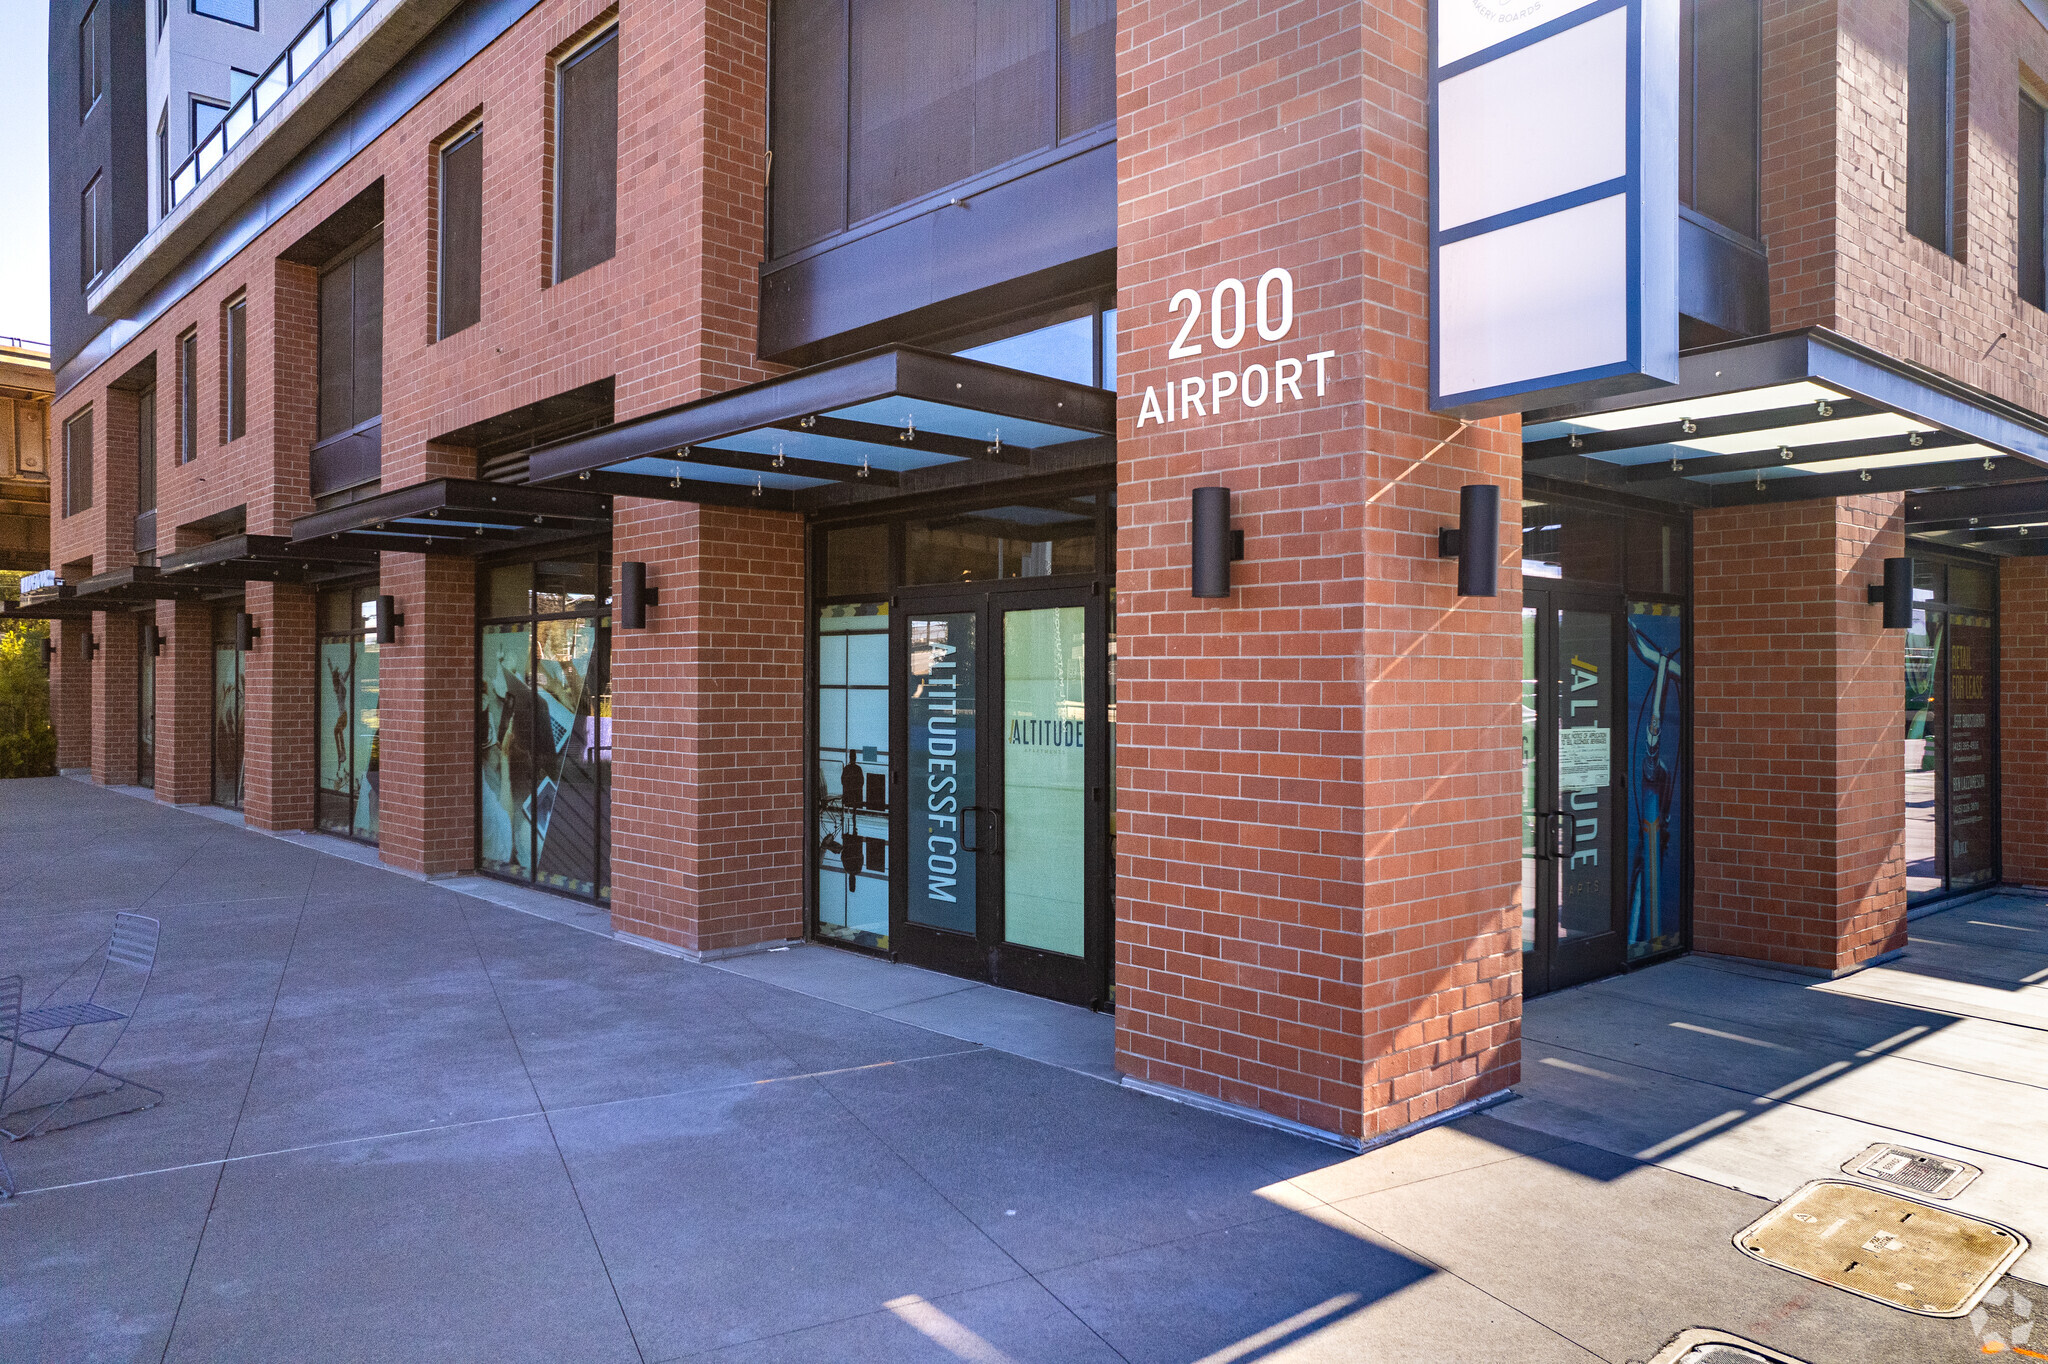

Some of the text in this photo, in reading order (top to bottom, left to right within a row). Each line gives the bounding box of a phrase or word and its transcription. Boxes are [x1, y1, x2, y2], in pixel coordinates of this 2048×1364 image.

[1168, 267, 1293, 360] 200
[1136, 350, 1335, 428] AIRPORT
[1952, 645, 1971, 669] RETAIL
[1952, 675, 1983, 699] FOR LEASE
[1010, 719, 1084, 747] ALTITUDE
[928, 641, 957, 904] ALTITUDESSF.COM
[1570, 669, 1599, 870] ALUDE
[1569, 879, 1600, 896] APTS
